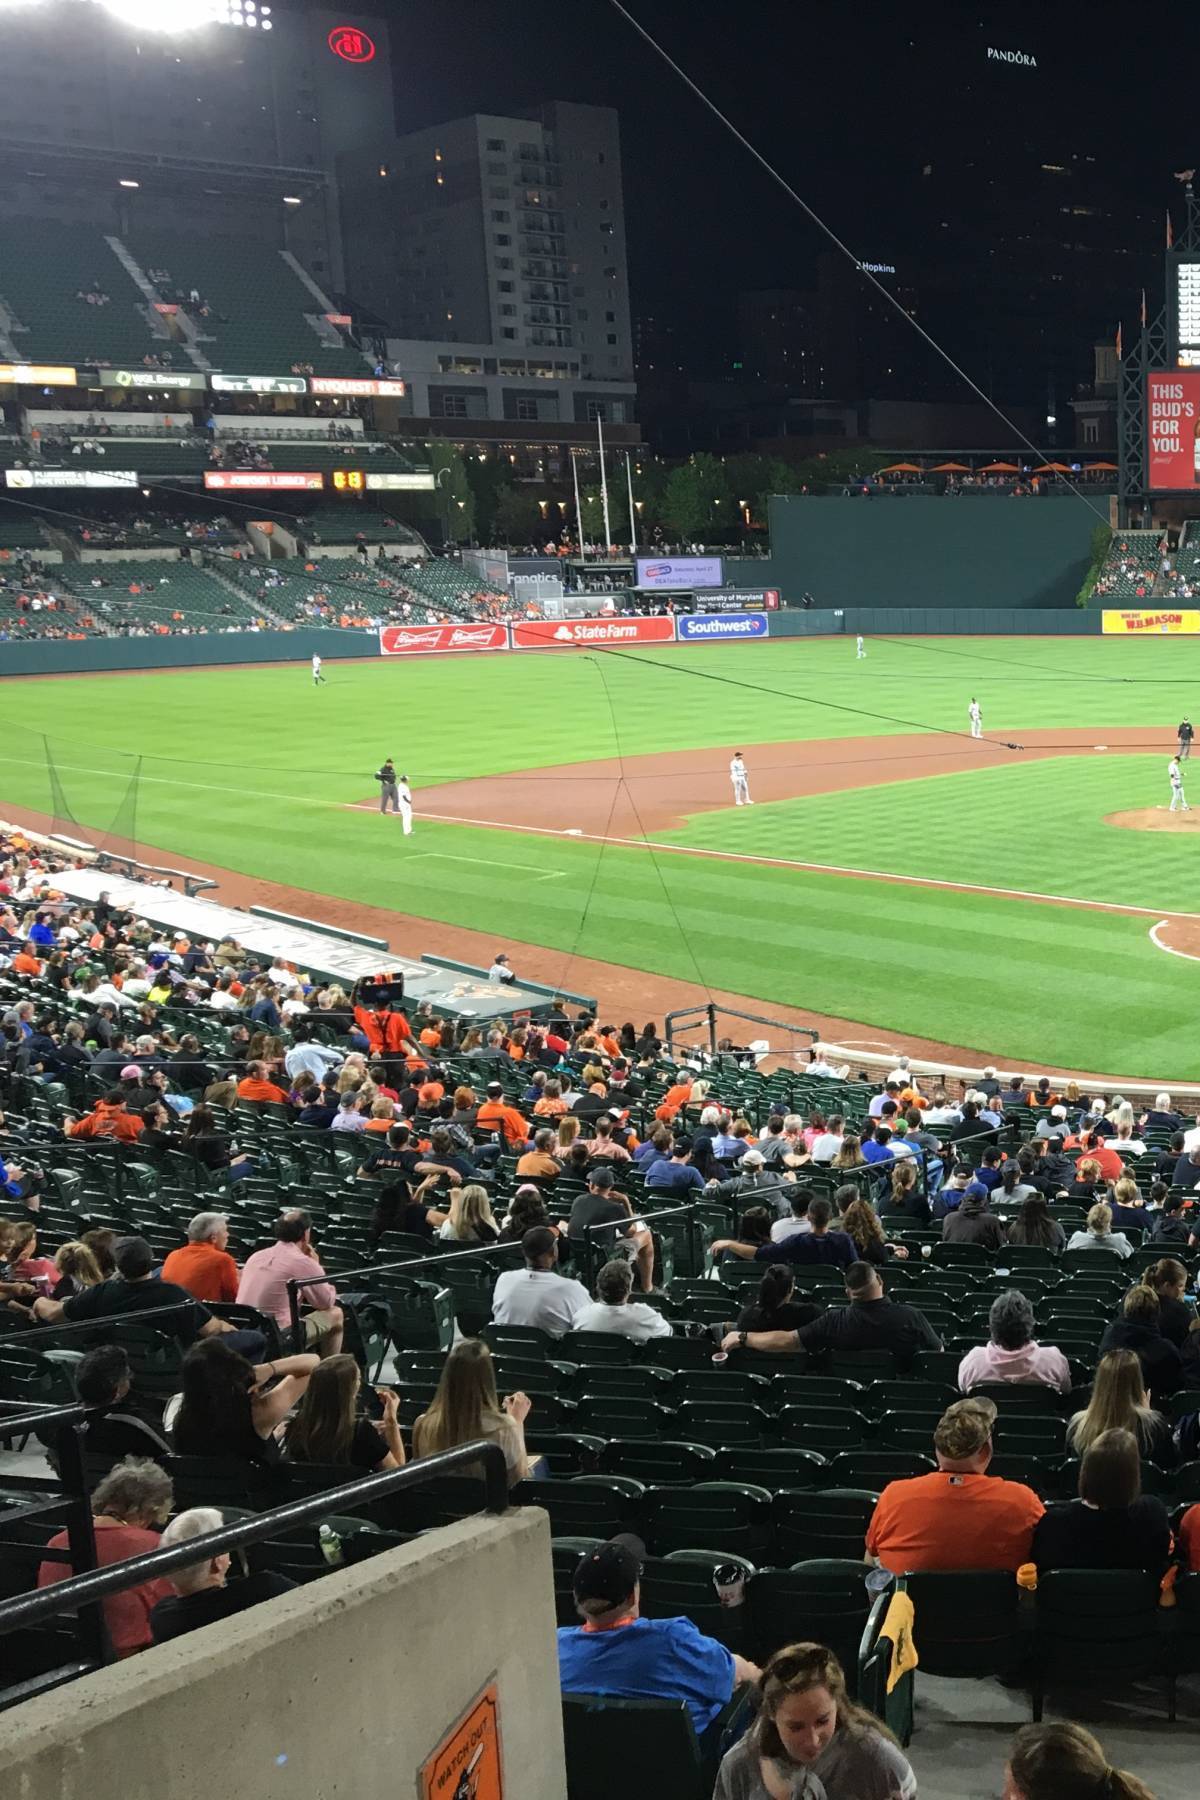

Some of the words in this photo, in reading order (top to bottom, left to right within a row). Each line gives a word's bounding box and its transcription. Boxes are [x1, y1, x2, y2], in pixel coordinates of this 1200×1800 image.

[862, 261, 896, 273] Hopkins
[157, 375, 191, 387] Energy
[1152, 384, 1183, 399] THIS
[1152, 402, 1194, 417] BUD'S
[1152, 420, 1179, 435] FOR
[1152, 438, 1184, 453] YOU.
[507, 571, 558, 585] Fanatics
[697, 594, 727, 602] University
[736, 593, 764, 602] Maryland
[687, 620, 751, 635] Southwest
[437, 1742, 470, 1790] WATCH
[470, 1715, 488, 1747] OUT
